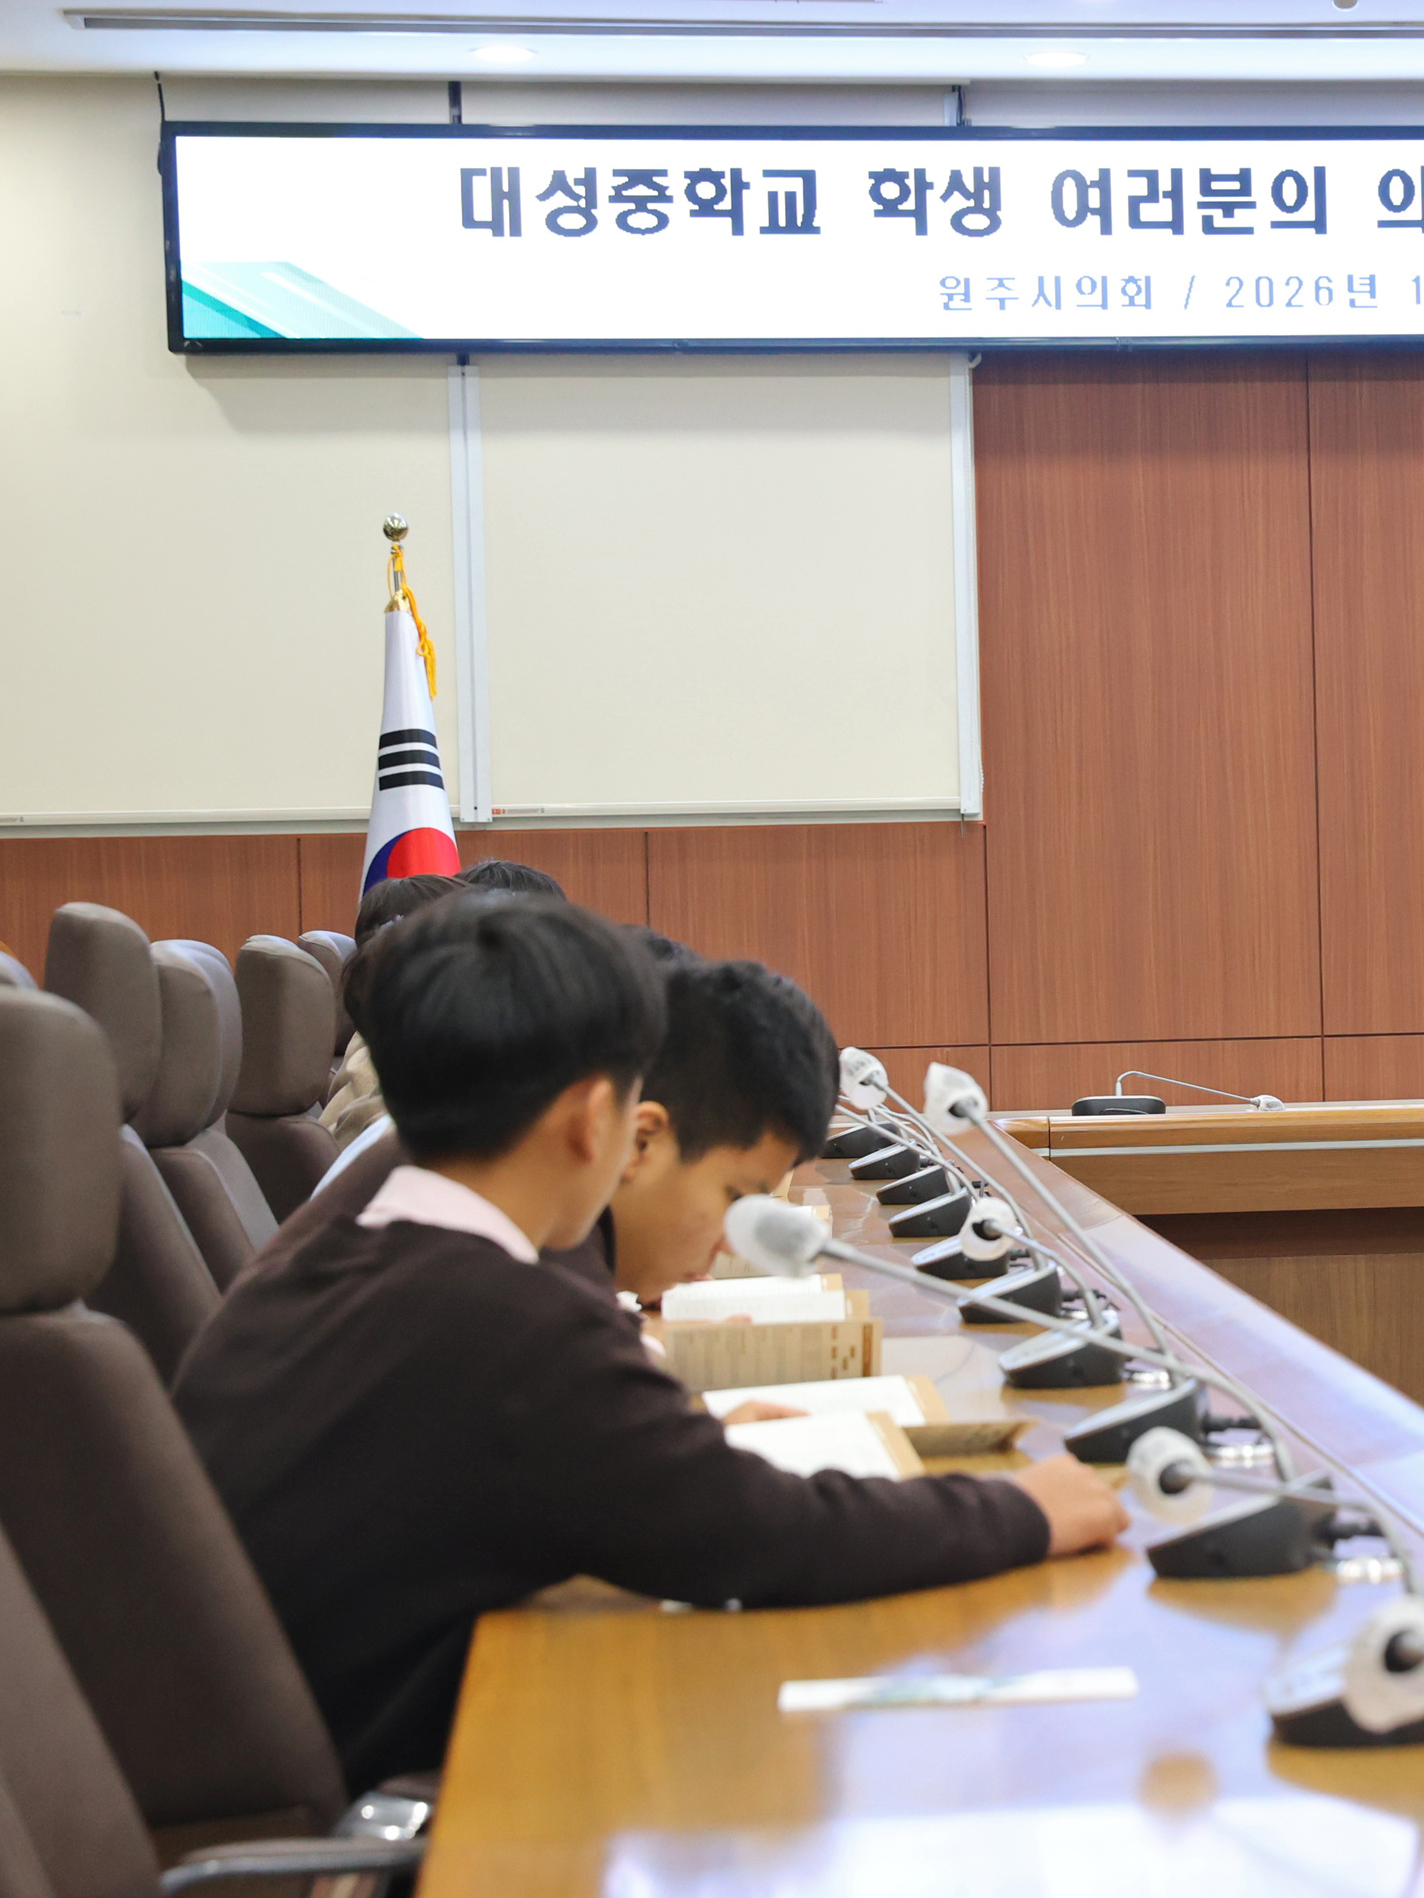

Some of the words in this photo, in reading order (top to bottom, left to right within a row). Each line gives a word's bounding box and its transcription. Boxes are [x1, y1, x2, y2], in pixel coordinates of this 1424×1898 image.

[460, 166, 821, 238] 대성중학교
[868, 166, 1002, 238] 학생
[1050, 165, 1328, 236] 여러분의
[938, 274, 1152, 312] 원주시의회
[1183, 274, 1197, 310] /
[1225, 273, 1379, 309] 2026년
